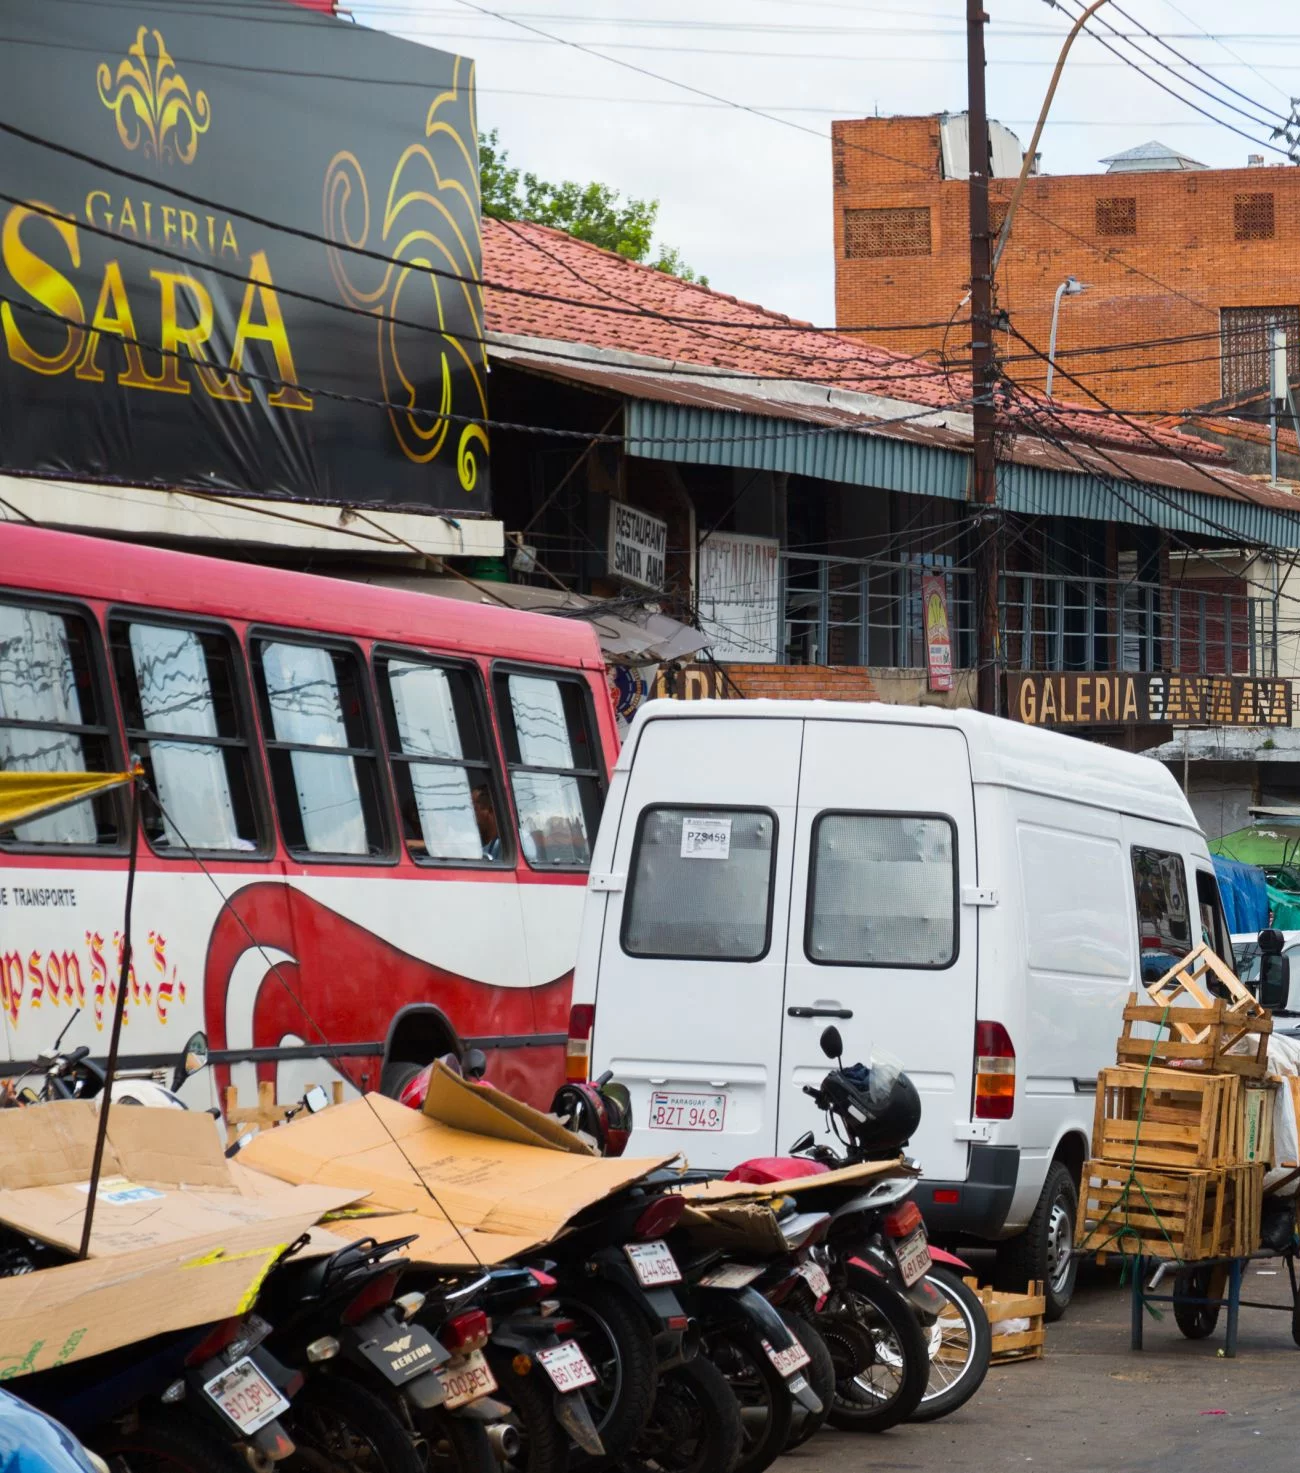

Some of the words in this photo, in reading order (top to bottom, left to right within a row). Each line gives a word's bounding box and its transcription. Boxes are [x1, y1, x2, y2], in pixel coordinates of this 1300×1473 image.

[86, 190, 242, 262] GALERIA
[2, 200, 313, 411] SARA
[616, 507, 666, 553] RESTAURANT
[615, 541, 642, 579] SANTA
[646, 555, 664, 592] ANA
[1020, 677, 1138, 724] GALERIA
[13, 888, 77, 906] TRANSPORTE
[656, 1106, 684, 1125] BZT
[689, 1107, 718, 1127] 949
[671, 1098, 706, 1106] PARAGUAY
[639, 1262, 659, 1279] 244
[391, 1343, 433, 1372] KENTON
[441, 1378, 468, 1401] 200
